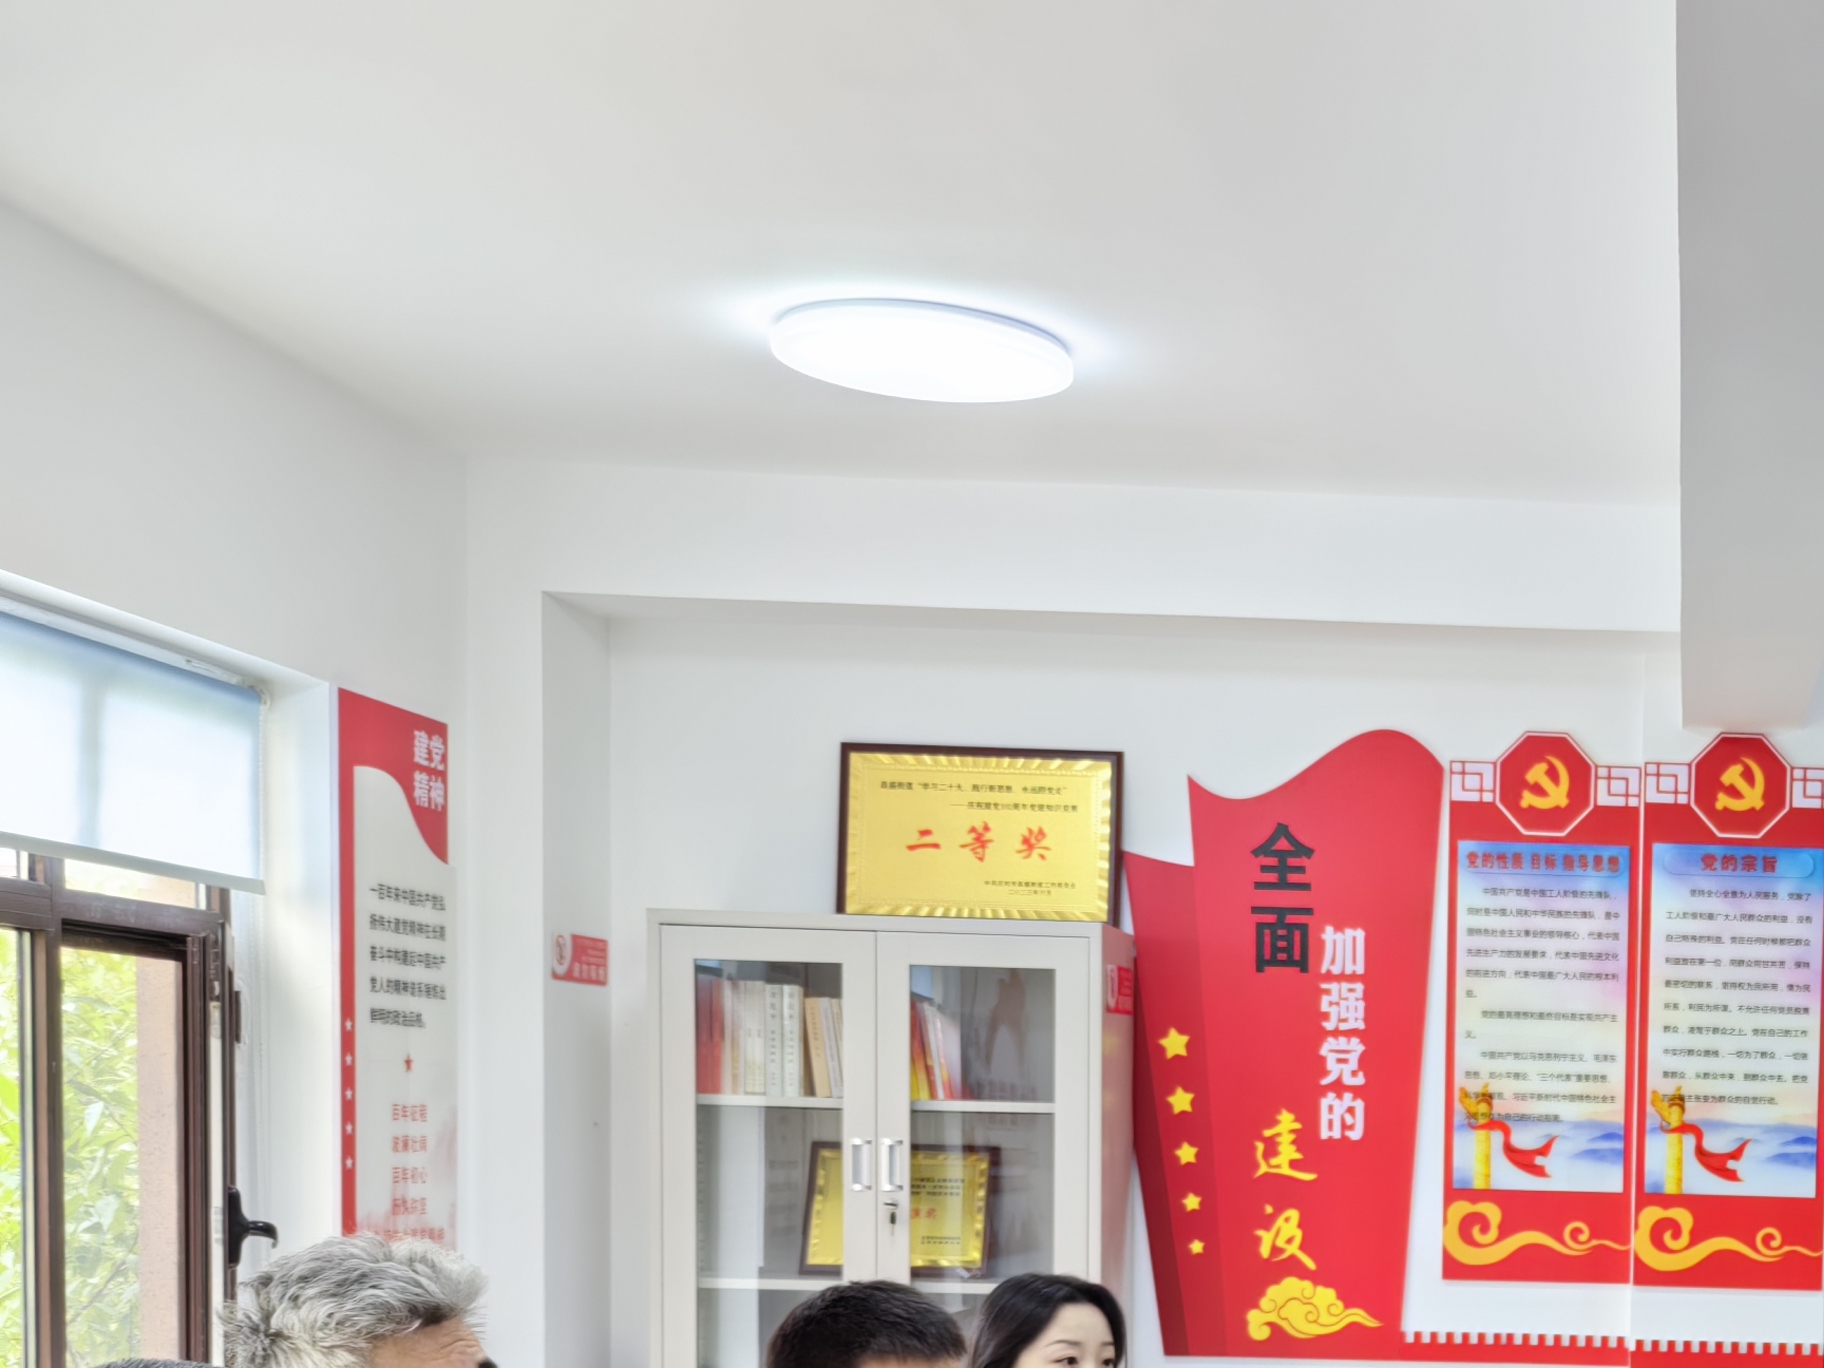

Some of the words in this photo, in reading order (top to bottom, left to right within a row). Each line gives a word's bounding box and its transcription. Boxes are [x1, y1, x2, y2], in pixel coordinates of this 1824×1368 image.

[906, 821, 1052, 863] 二等奖
[1467, 851, 1523, 869] 党的性质
[1531, 853, 1556, 870] 目标
[1701, 853, 1778, 873] 党的宗旨
[1250, 822, 1315, 973] 全面
[1318, 924, 1366, 1141] 加强党的
[1253, 1108, 1318, 1271] 建设
